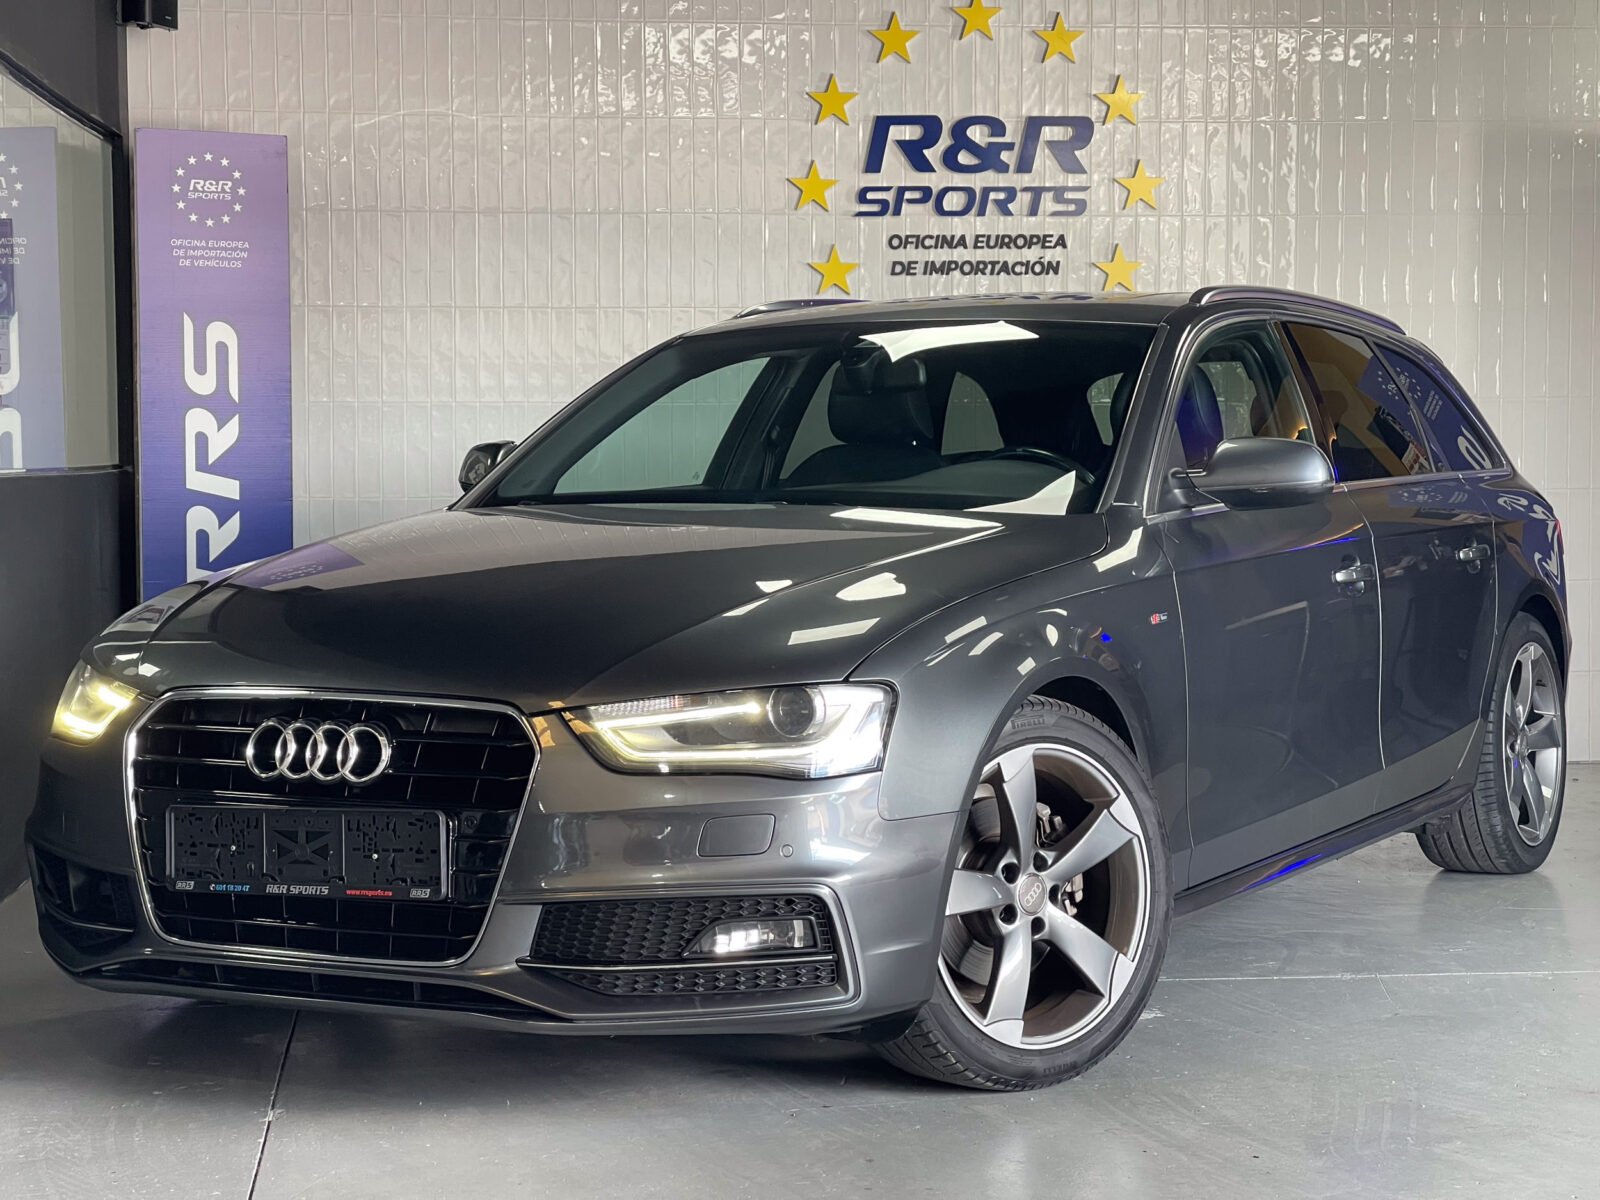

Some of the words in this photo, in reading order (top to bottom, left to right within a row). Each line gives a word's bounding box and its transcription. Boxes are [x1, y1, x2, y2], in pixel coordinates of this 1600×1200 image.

[864, 114, 1094, 174] R&R
[189, 178, 232, 192] R&R
[187, 191, 232, 200] SPORTS
[854, 186, 1091, 217] SPORTS
[170, 238, 206, 247] OFICINA
[208, 240, 250, 248] EUROPEA
[888, 234, 968, 250] OFICINA
[973, 233, 1068, 250] EUROPEA
[187, 249, 248, 259] IMPORTACIÓN
[194, 258, 242, 268] VEHÍCULOS
[890, 260, 918, 276] DE
[923, 256, 1061, 276] IMPORTACIÓN
[266, 884, 288, 894] R&R
[289, 885, 330, 895] SPORTS
